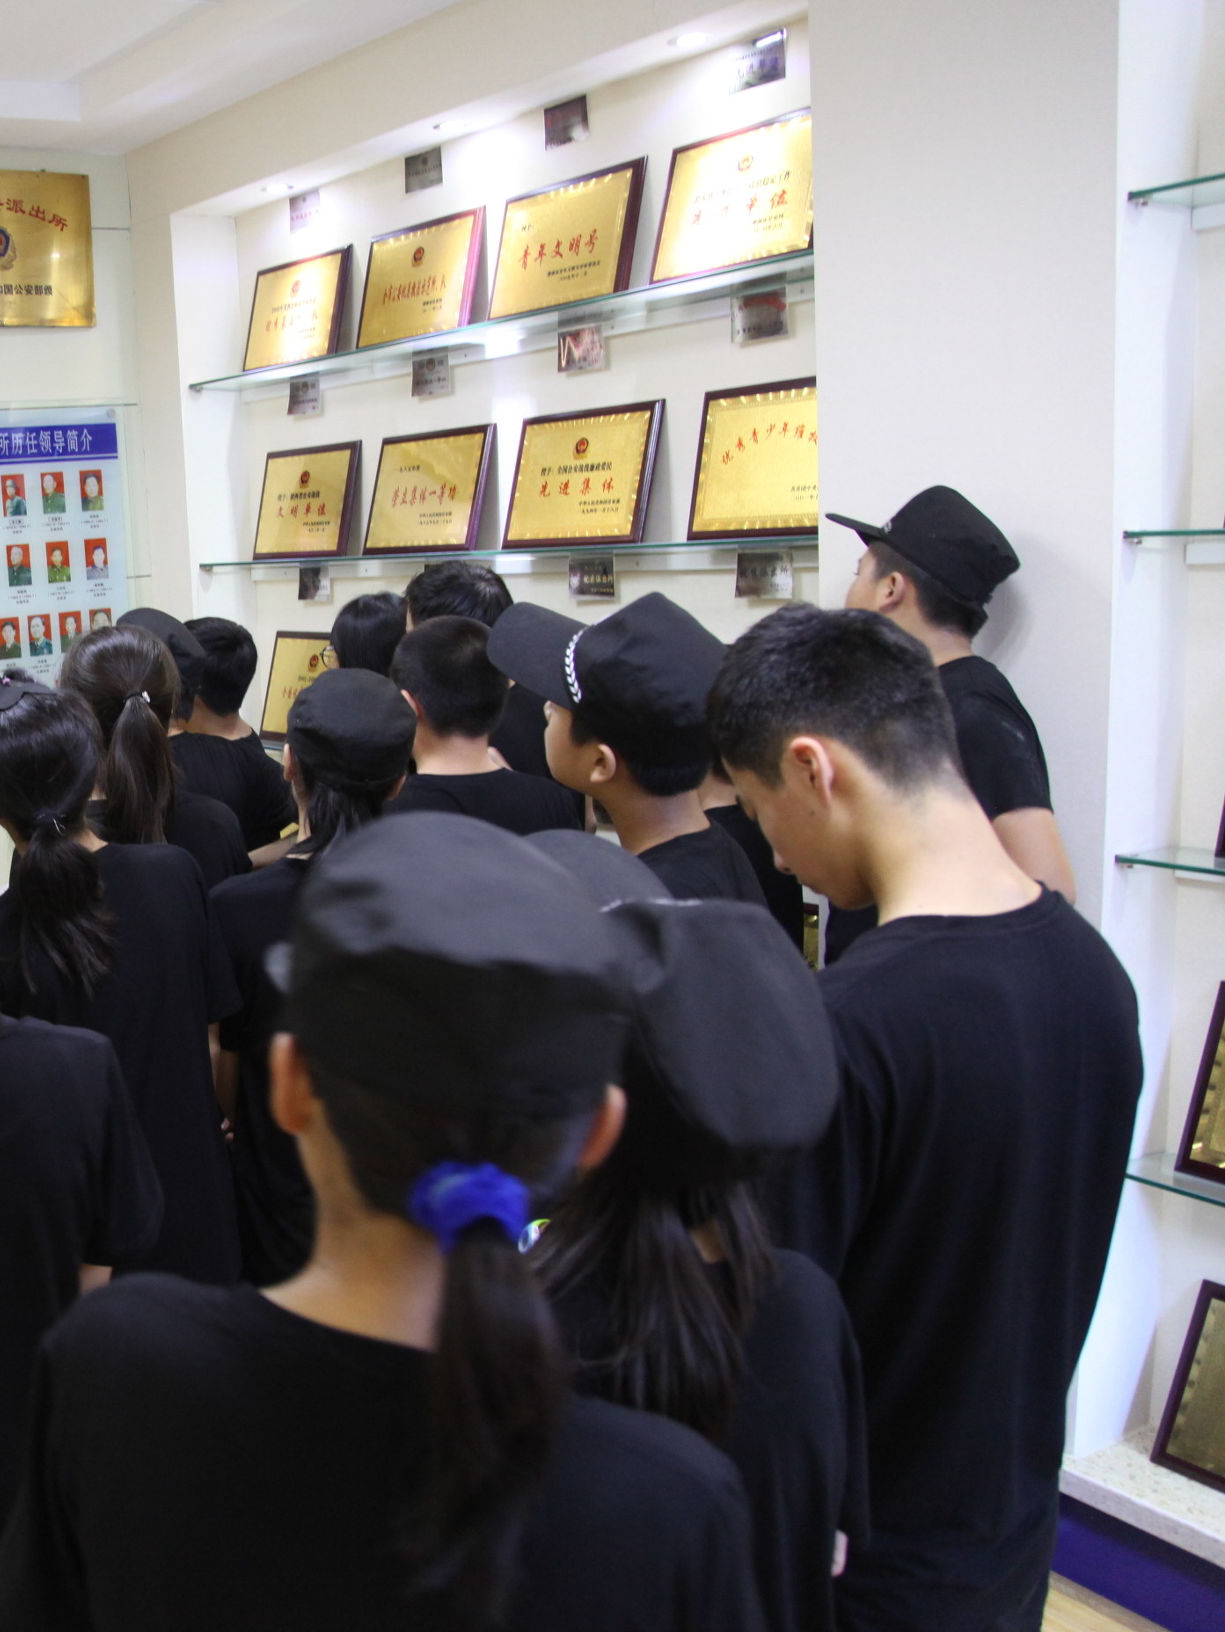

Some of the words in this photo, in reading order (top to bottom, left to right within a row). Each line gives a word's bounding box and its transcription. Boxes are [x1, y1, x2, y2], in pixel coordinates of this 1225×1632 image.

[519, 228, 598, 271] 青年文明号
[539, 477, 614, 497] 先进集体
